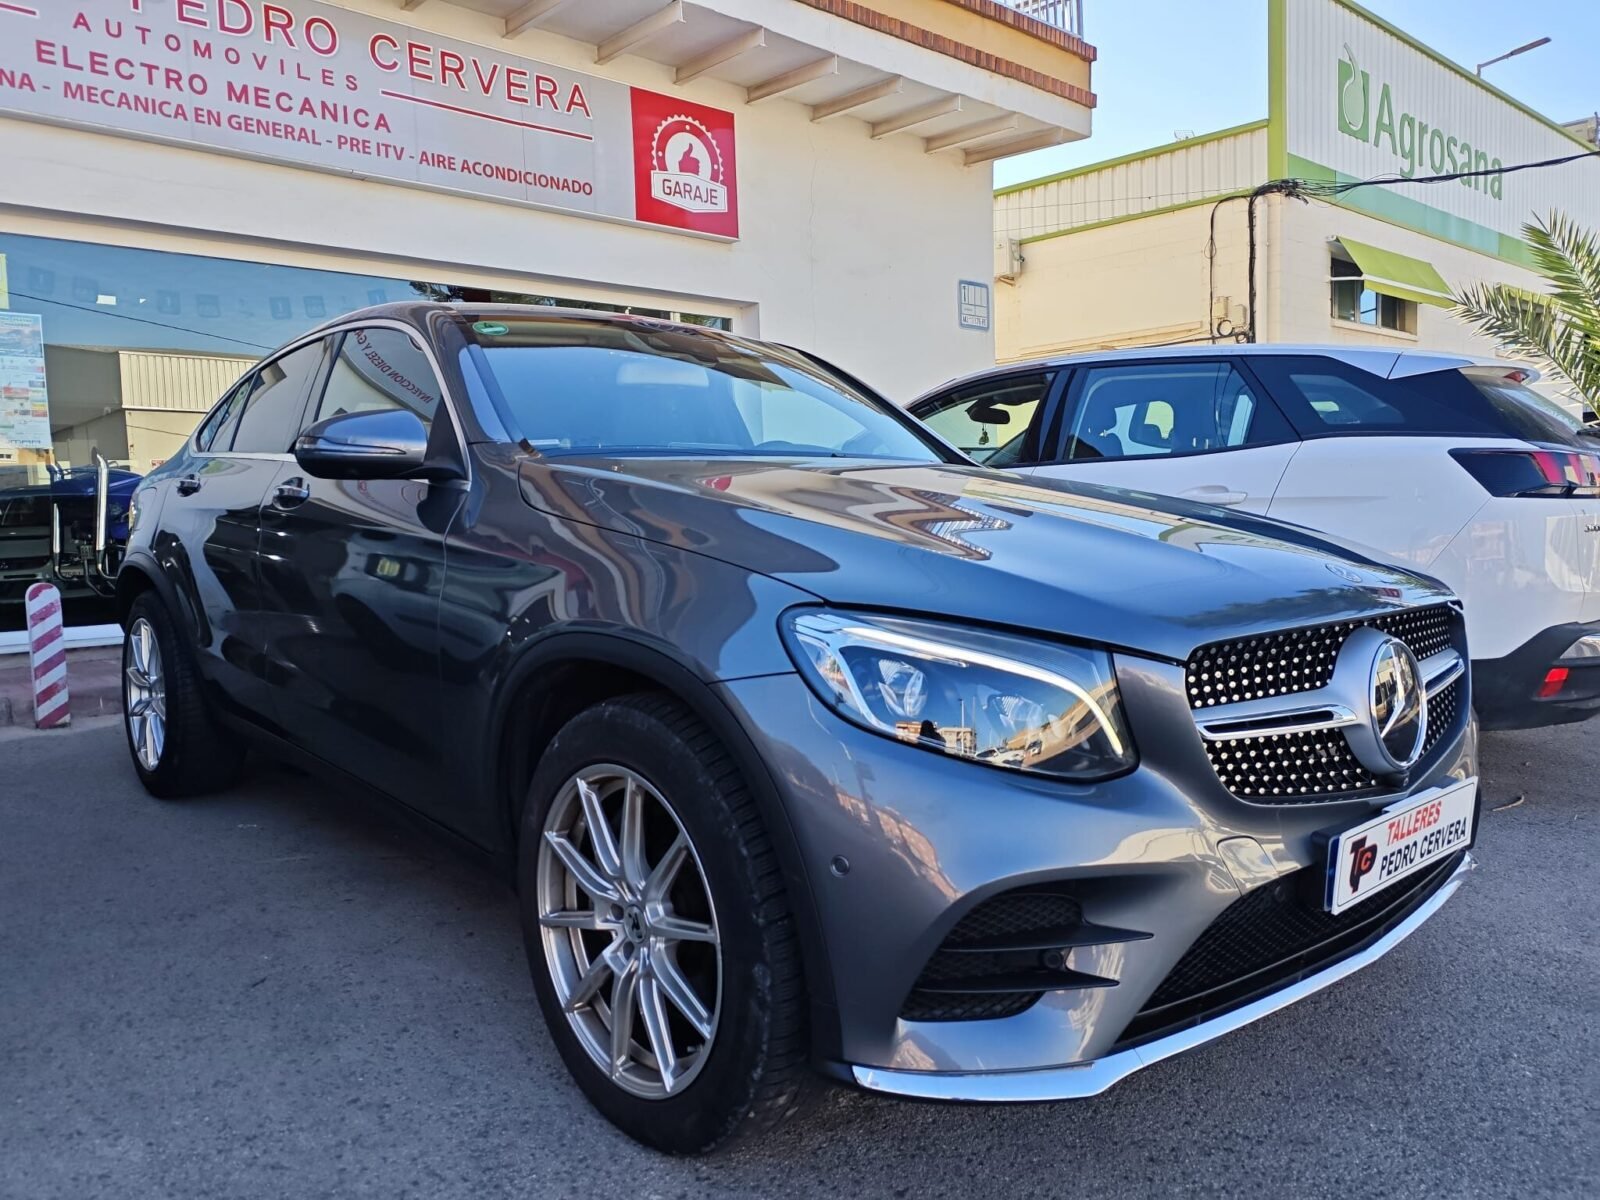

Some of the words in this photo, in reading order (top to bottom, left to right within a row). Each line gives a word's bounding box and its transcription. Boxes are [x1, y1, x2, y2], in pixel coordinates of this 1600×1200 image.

[35, 39, 208, 95] ELECTRO
[227, 81, 391, 133] MECANICA
[73, 12, 358, 91] AUTOMOVILES
[369, 34, 592, 119] CERVERA
[63, 81, 188, 121] MECANICA
[193, 106, 222, 127] EN
[227, 114, 322, 146] GENERAL
[337, 134, 372, 155] PRE
[376, 142, 404, 161] ITV
[419, 151, 456, 171] AIRE
[460, 159, 593, 196] ACONDICIONADO
[1374, 83, 1502, 200] Agrosana
[662, 178, 718, 206] GARAJE
[1379, 840, 1417, 880] PEDRO
[1420, 817, 1467, 859] CERVERA
[1387, 801, 1442, 846] TALLERES
